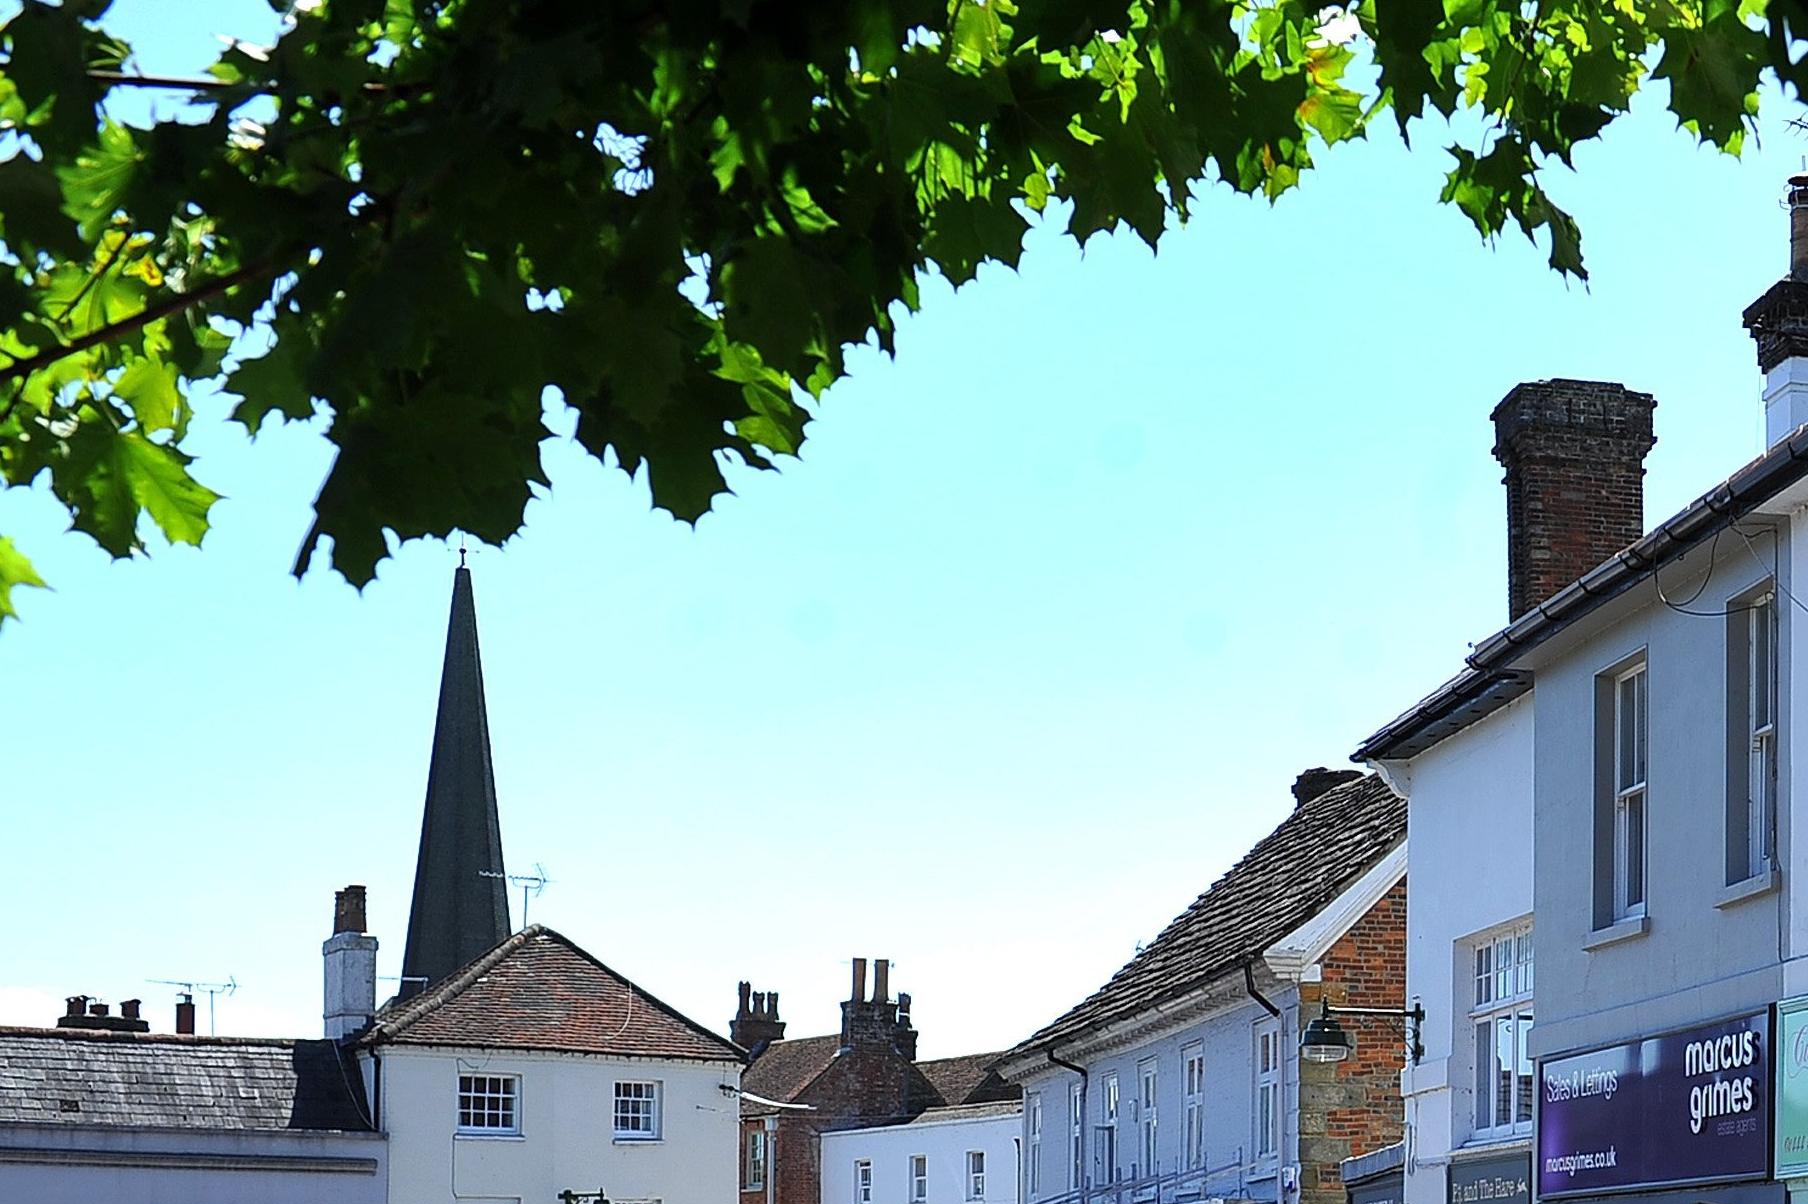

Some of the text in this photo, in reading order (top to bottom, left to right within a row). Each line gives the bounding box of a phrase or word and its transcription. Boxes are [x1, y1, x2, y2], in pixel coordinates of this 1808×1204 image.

[1684, 1029, 1753, 1077] marcus
[1546, 1066, 1618, 1102] Sales & Lettings
[1689, 1075, 1753, 1134] grimes
[1545, 1145, 1617, 1177] marcusgrimes.co.uk
[1464, 1180, 1478, 1202] and
[1479, 1179, 1494, 1200] The
[1494, 1177, 1515, 1198] Hare
